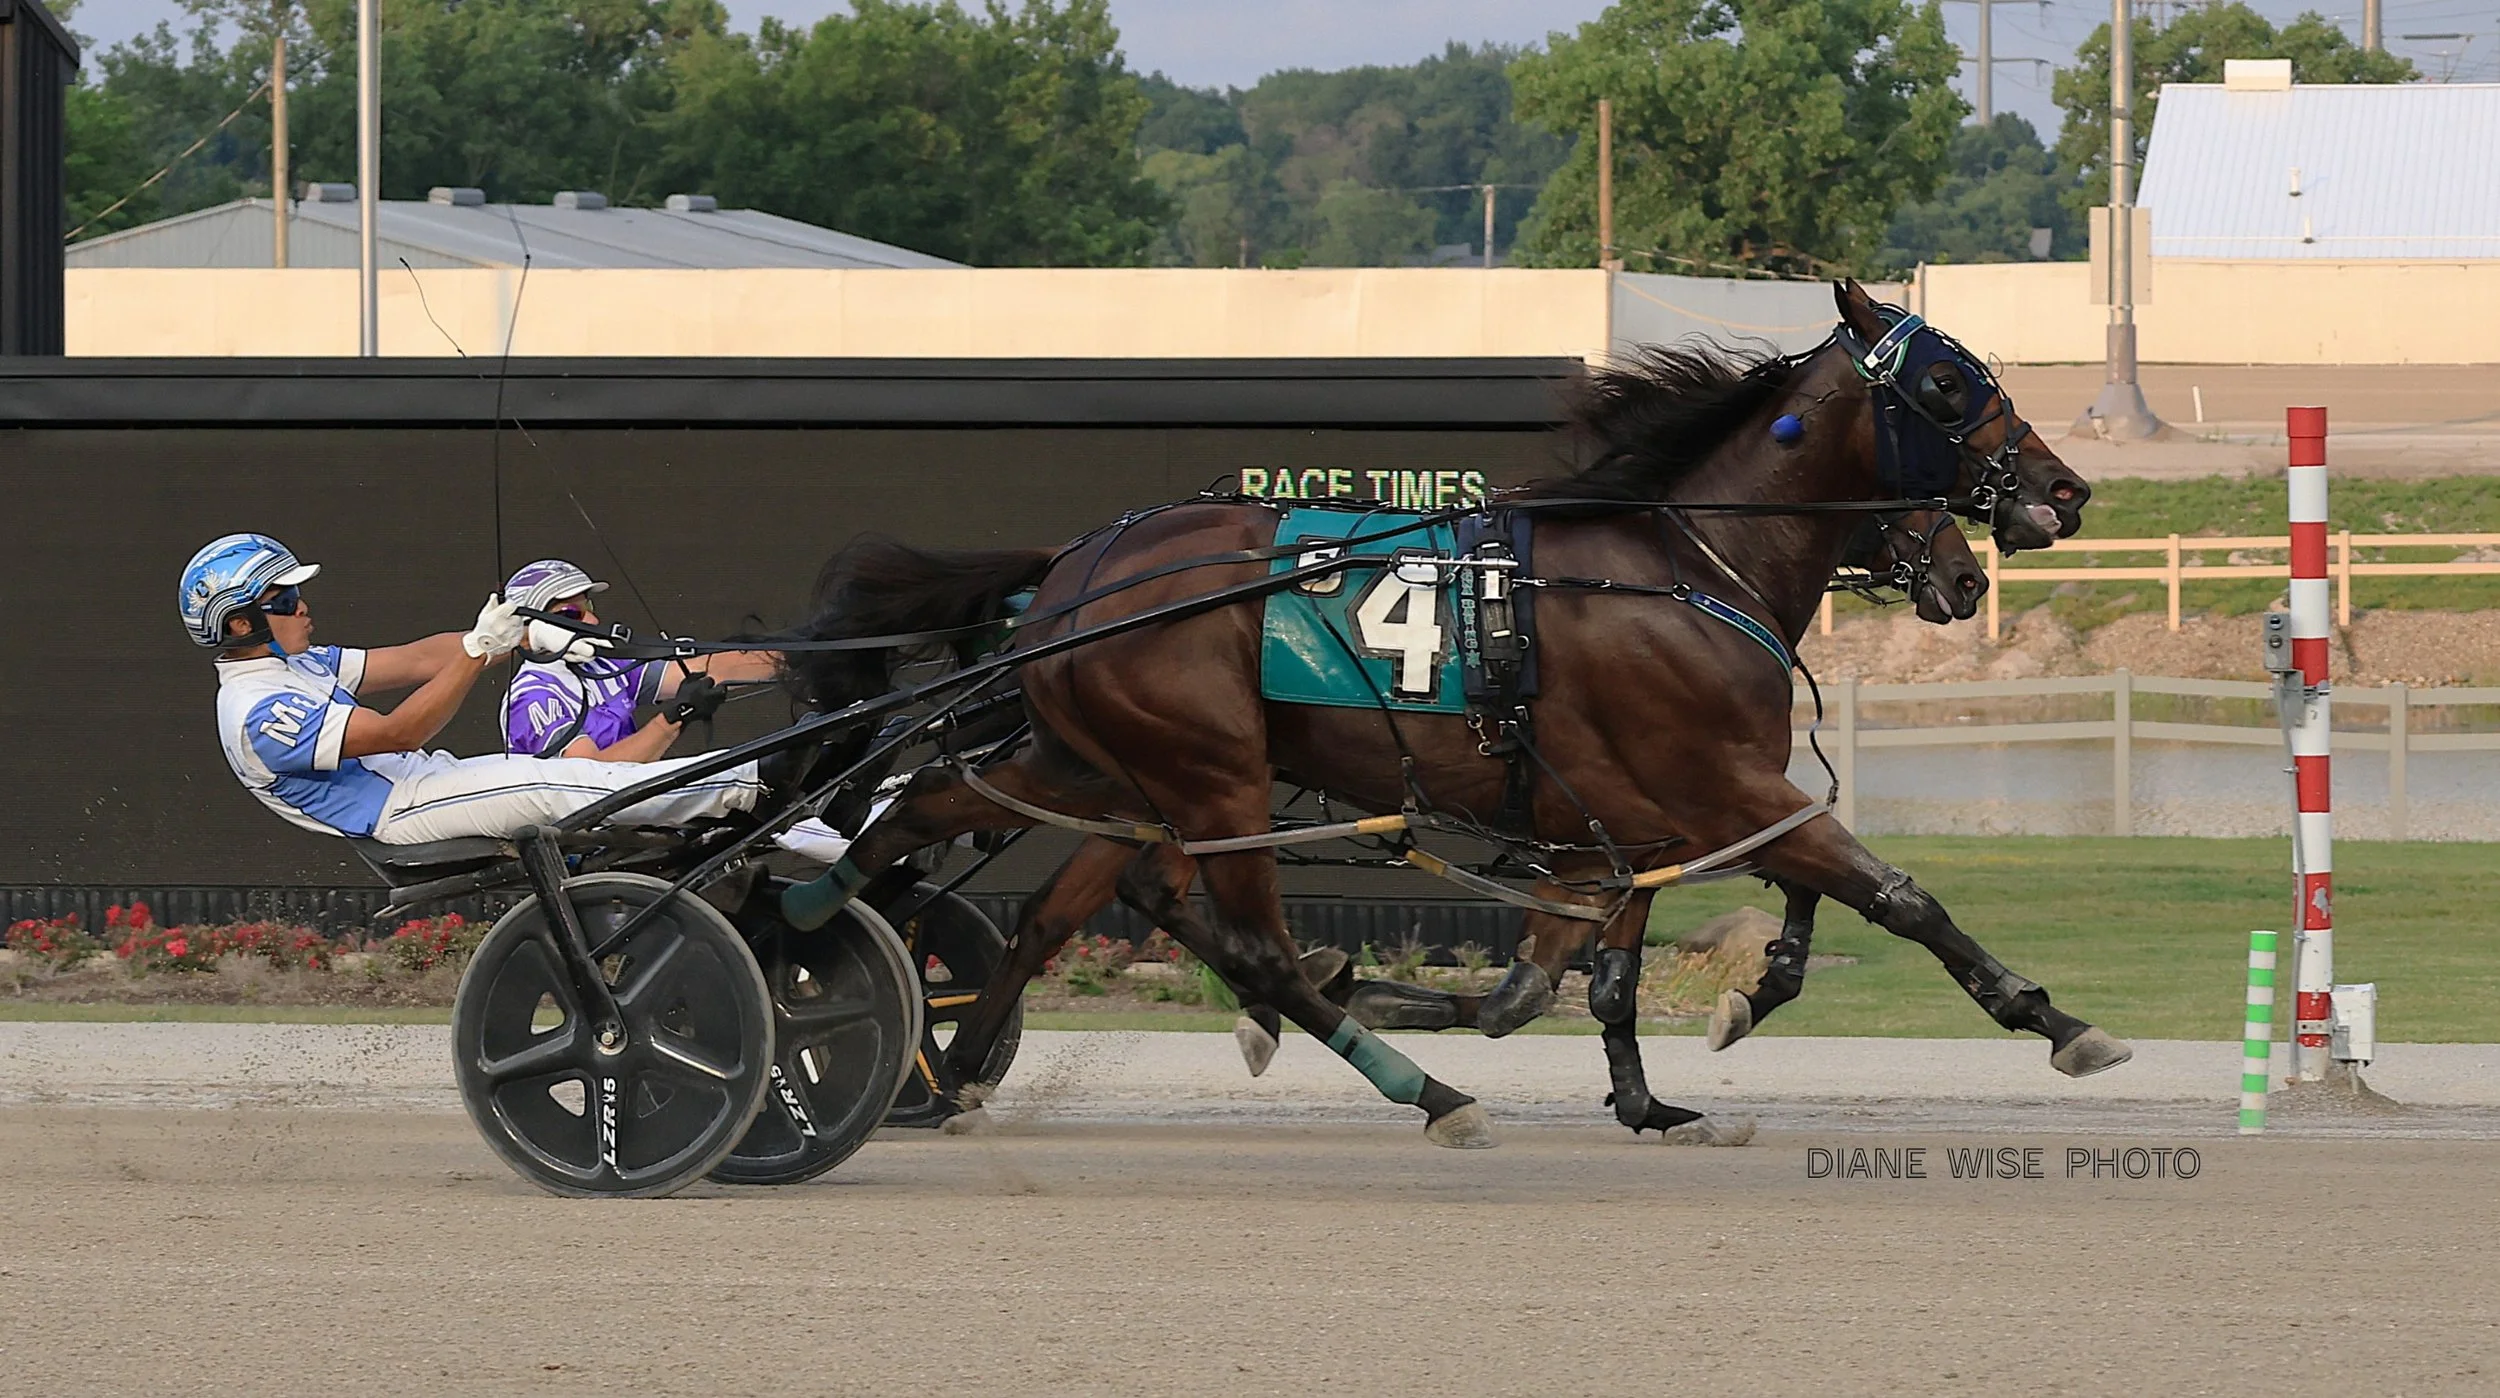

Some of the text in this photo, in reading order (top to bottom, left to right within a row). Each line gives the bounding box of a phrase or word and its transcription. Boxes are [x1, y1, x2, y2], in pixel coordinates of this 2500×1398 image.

[1241, 468, 1485, 510] RACE TIMES
[1356, 555, 1442, 693] 4
[603, 1104, 616, 1166] LZR
[780, 1088, 817, 1136] LZR
